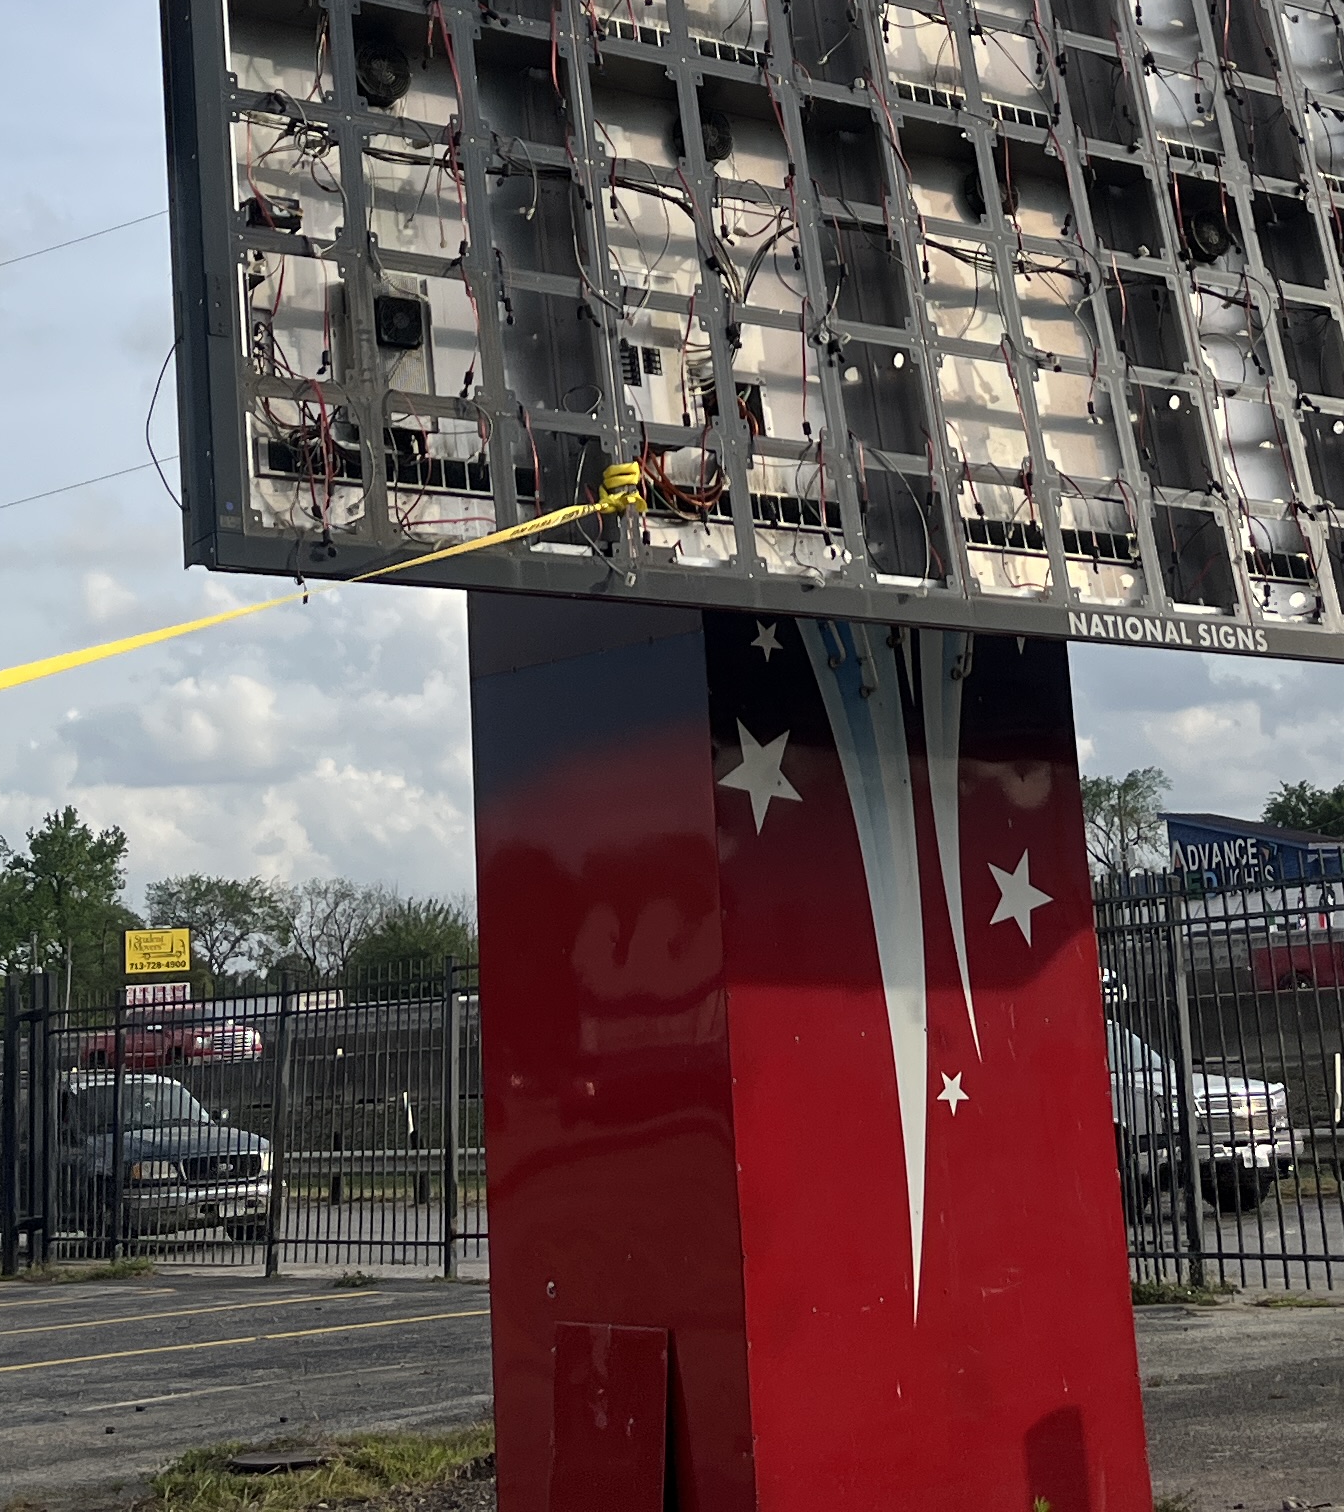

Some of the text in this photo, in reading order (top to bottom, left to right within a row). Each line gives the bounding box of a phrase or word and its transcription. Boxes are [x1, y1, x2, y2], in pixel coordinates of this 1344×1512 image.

[1068, 611, 1269, 653] NATIONAL SIGNS
[1171, 838, 1259, 872] ADVANCE
